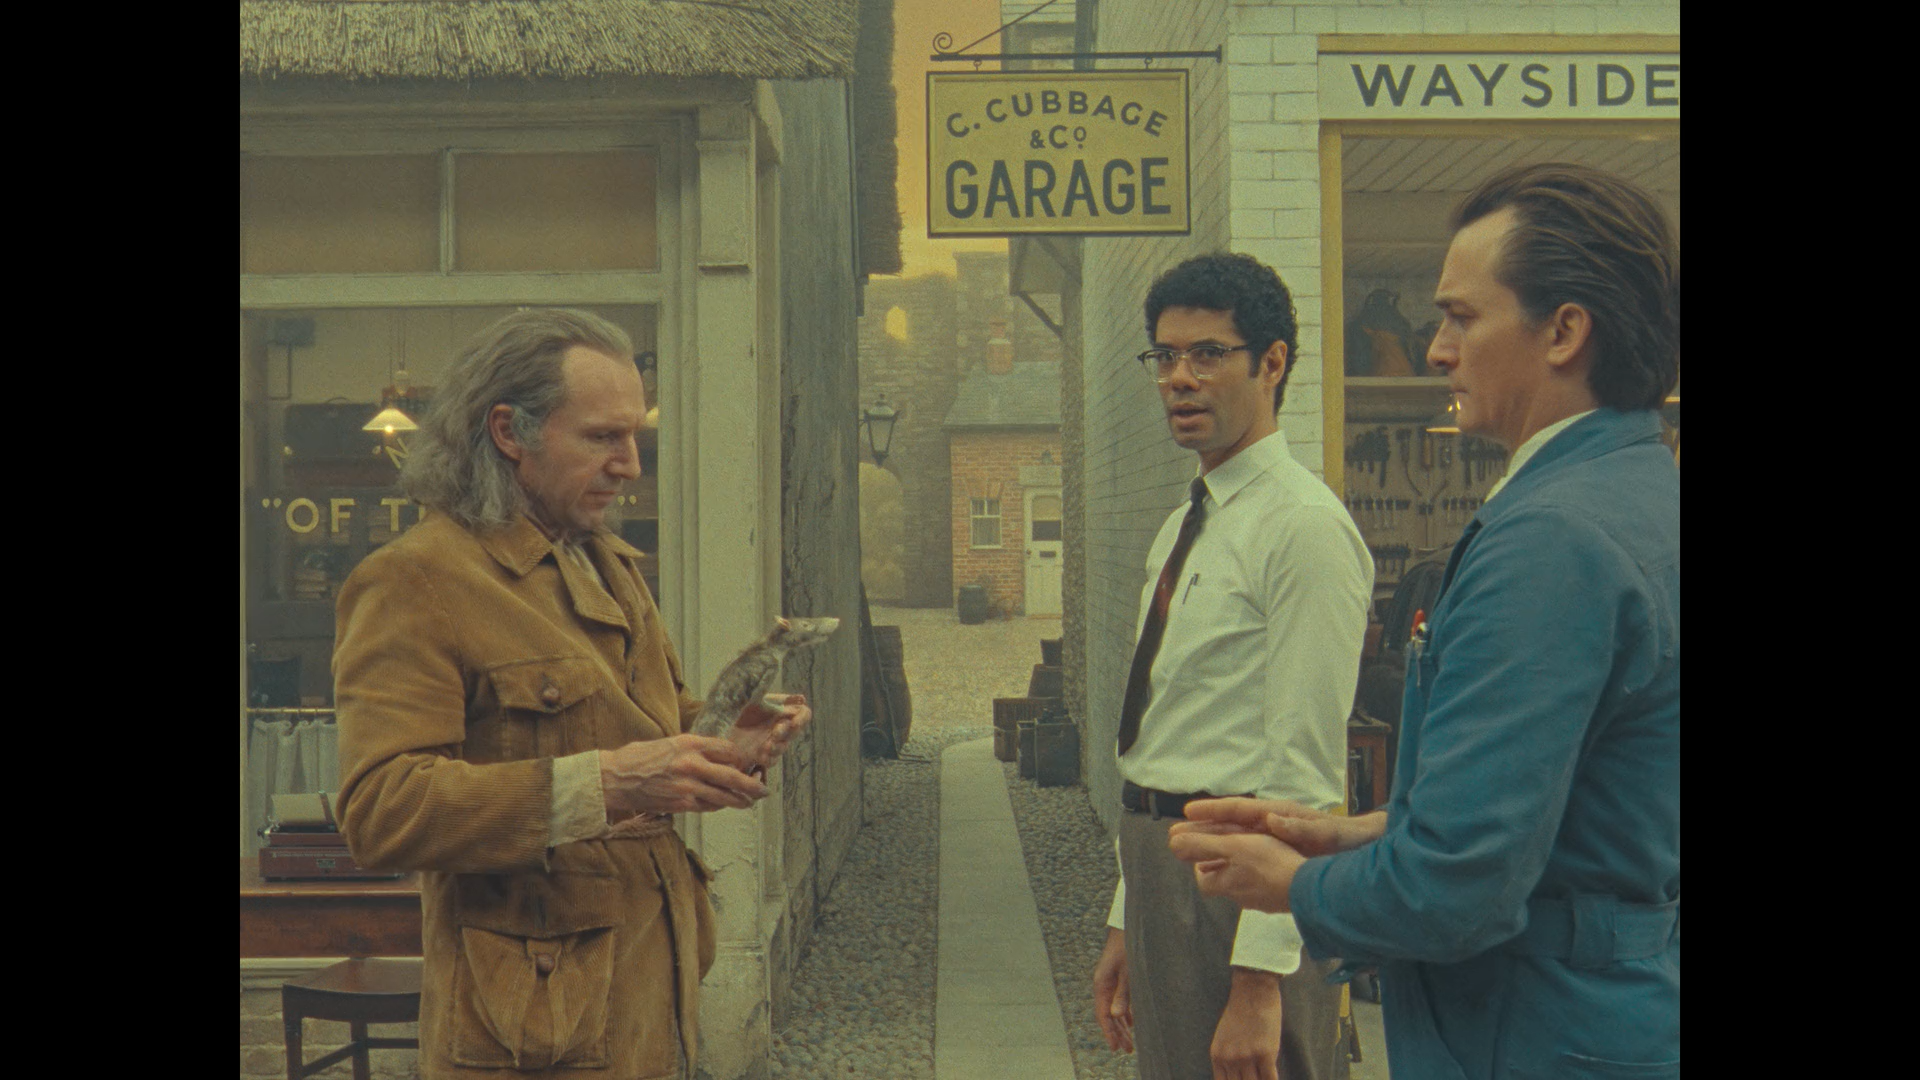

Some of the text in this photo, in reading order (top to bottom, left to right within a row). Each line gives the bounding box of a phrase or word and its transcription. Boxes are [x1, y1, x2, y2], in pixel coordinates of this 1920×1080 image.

[1350, 63, 1679, 107] WAYSIDE
[946, 90, 1168, 138] C. CUBBAGE
[945, 157, 1172, 219] GARAGE
